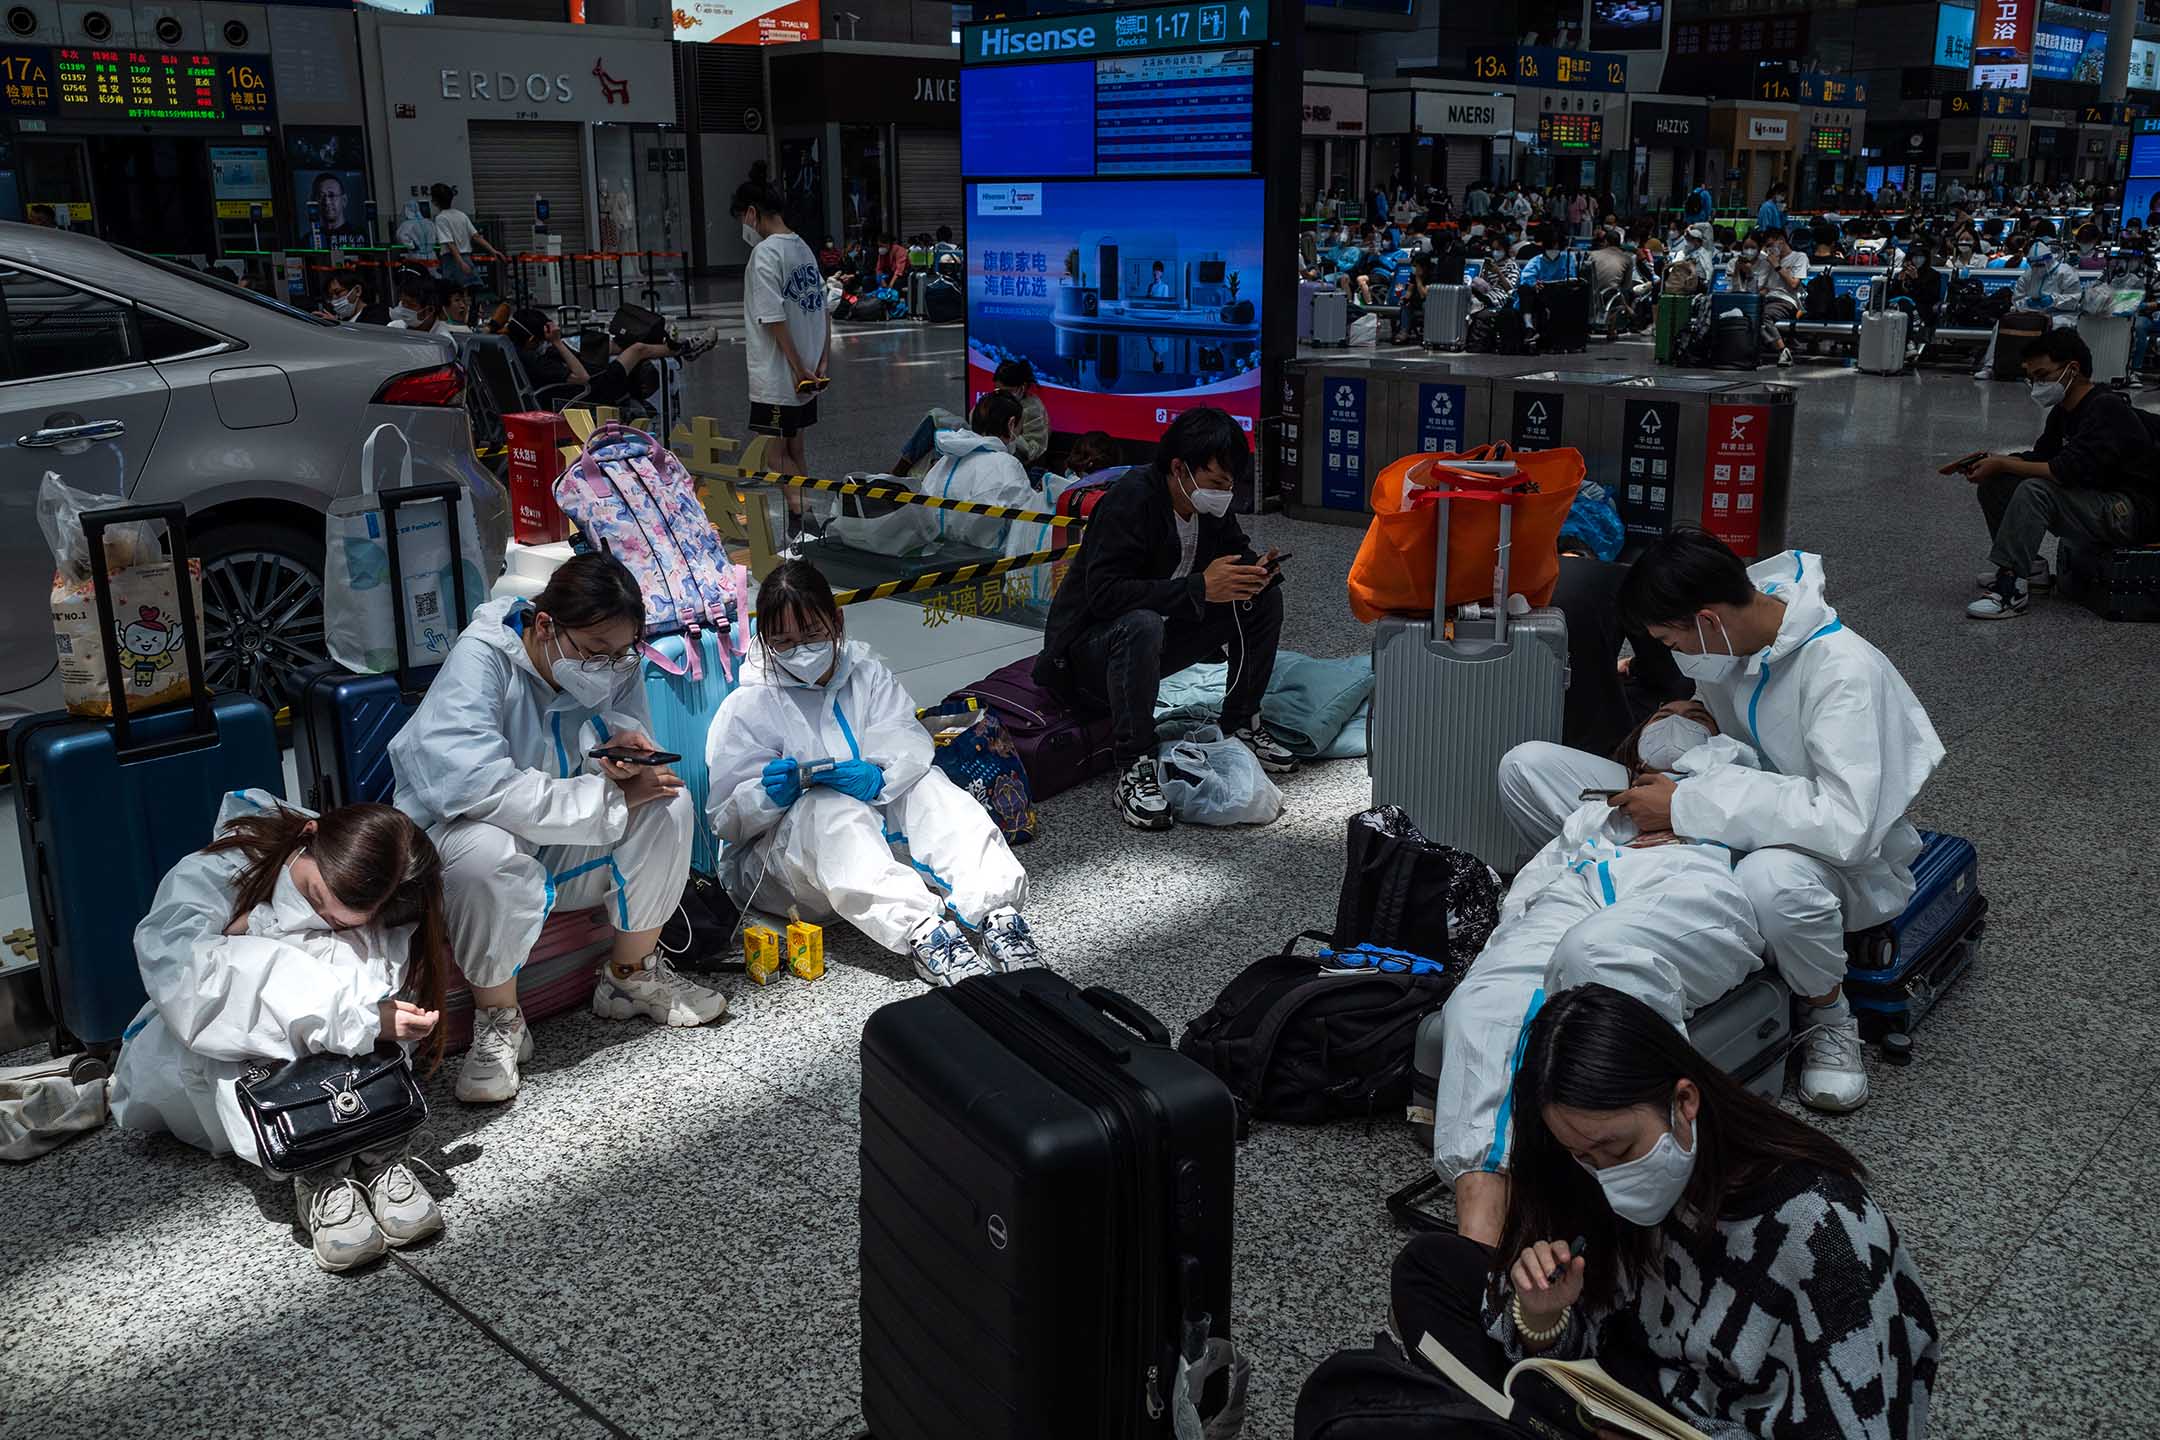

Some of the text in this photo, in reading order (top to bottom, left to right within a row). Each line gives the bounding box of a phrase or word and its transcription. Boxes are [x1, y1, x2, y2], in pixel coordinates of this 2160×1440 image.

[1155, 12, 1190, 38] 1-17
[1993, 0, 2017, 40] 卫浴
[980, 26, 1096, 56] Hisense
[1116, 37, 1136, 48] Check
[1, 56, 47, 81] 17A
[226, 65, 265, 89] 16A
[1474, 55, 1507, 77] 13A
[1519, 55, 1539, 77] 13A
[6, 84, 49, 98] 检票口
[440, 69, 577, 104] ERDOS
[914, 77, 960, 102] JAKE
[1762, 80, 1790, 98] 11A
[11, 98, 37, 106] Check
[230, 91, 268, 105] 检票口
[1448, 105, 1495, 124] NAERSI
[2086, 108, 2102, 121] 7A
[1656, 119, 1689, 134] HAZZYS
[411, 185, 459, 199] ERS
[983, 250, 1047, 272] 旗舰家电
[984, 276, 1047, 297] 海信优选
[922, 574, 1033, 629] 玻璃易碎
